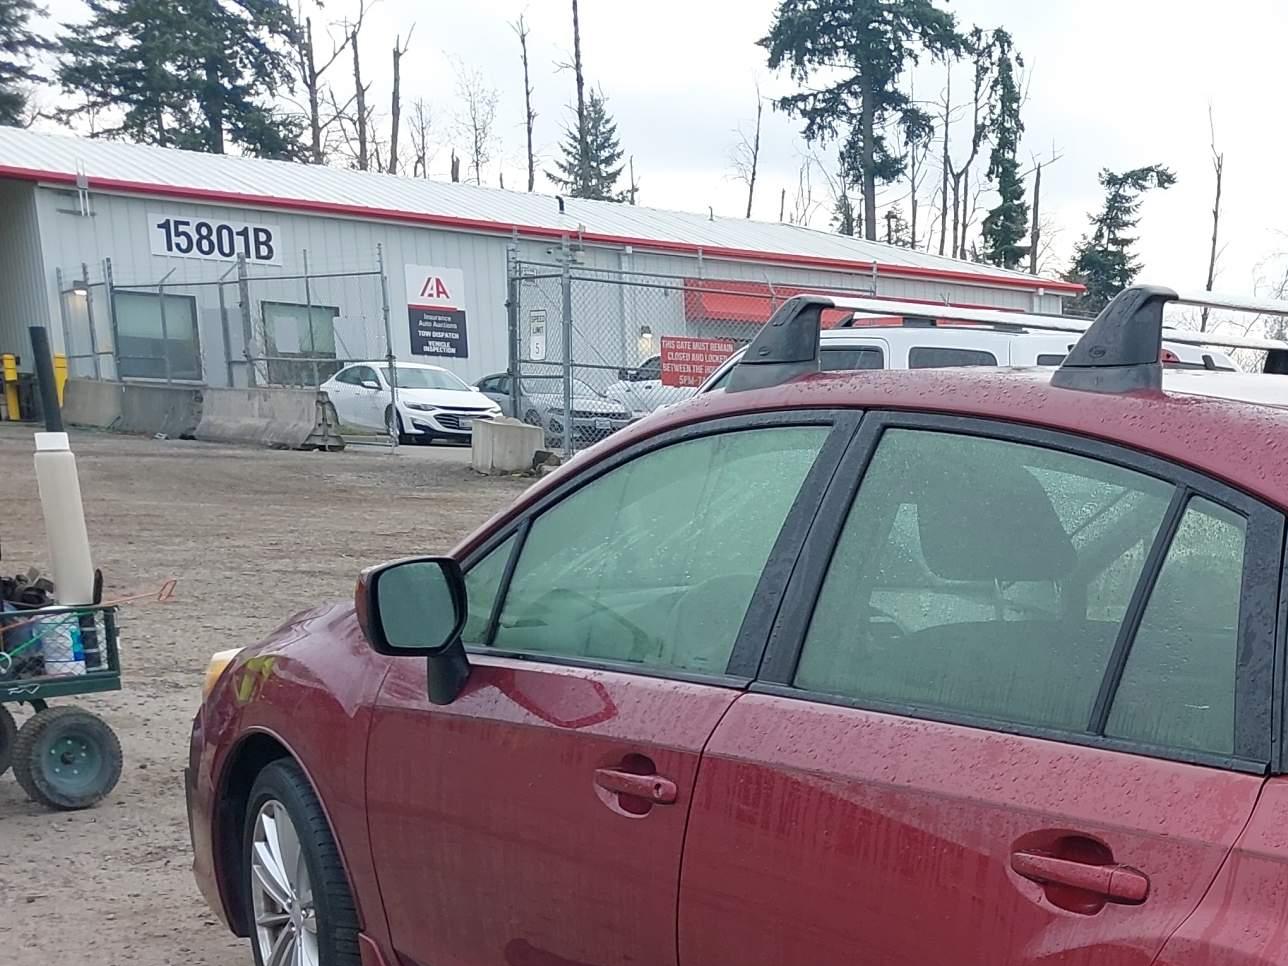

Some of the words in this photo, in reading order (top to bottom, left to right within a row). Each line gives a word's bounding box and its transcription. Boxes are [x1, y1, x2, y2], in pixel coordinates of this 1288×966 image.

[157, 218, 274, 261] 15801B
[423, 313, 452, 322] Insurance
[531, 315, 545, 323] SPEED
[432, 321, 458, 329] Auctions
[418, 330, 431, 338] TOW
[432, 331, 459, 339] DISPATCH
[532, 326, 544, 334] LIMIT
[427, 340, 451, 348] VEHICLE
[535, 342, 540, 354] 5
[662, 340, 675, 349] THIS
[676, 341, 692, 350] GATE
[692, 342, 709, 351] MUST
[709, 343, 734, 352] REMAIN
[423, 345, 456, 354] INSPECTION
[667, 351, 690, 361] CLOSED
[691, 353, 704, 361] AND
[663, 363, 691, 373] BETWEEN
[692, 365, 705, 373] THE
